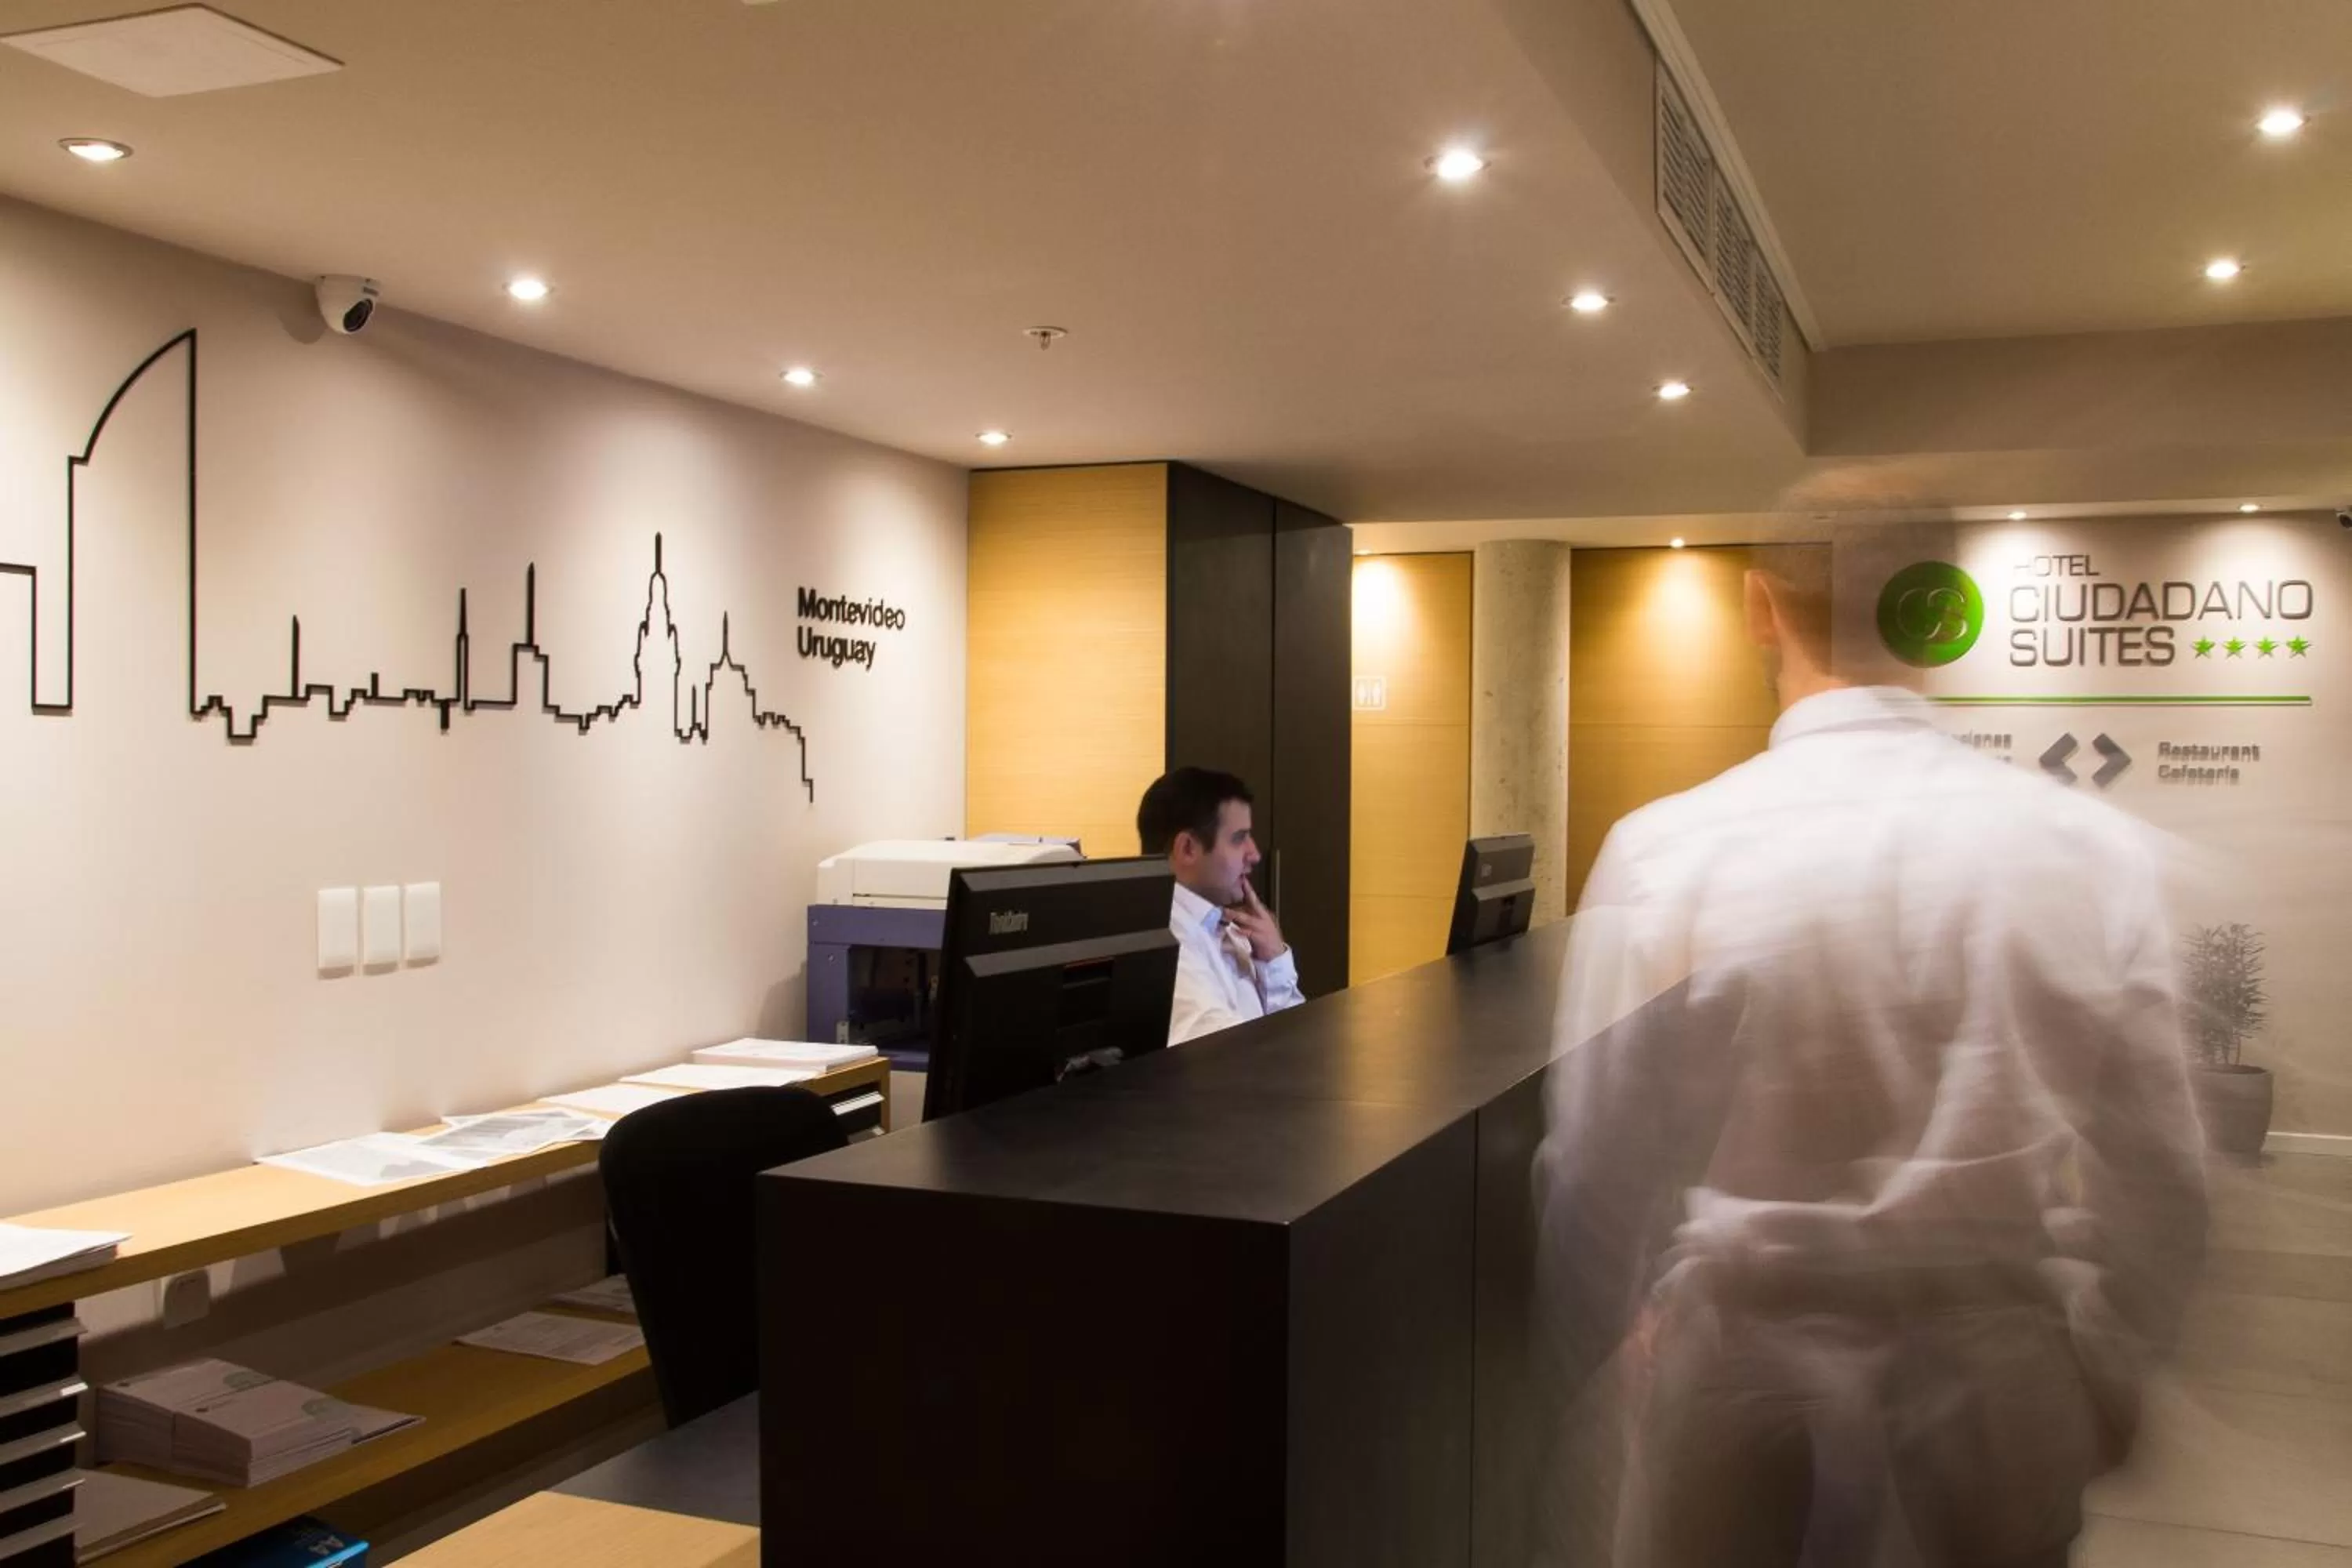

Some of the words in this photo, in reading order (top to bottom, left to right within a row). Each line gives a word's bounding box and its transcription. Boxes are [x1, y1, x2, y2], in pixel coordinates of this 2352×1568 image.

[797, 586, 906, 630] Montevideo
[2010, 581, 2314, 622] CIUDADANO
[797, 626, 876, 671] Uruguay
[2009, 626, 2176, 667] SUITES
